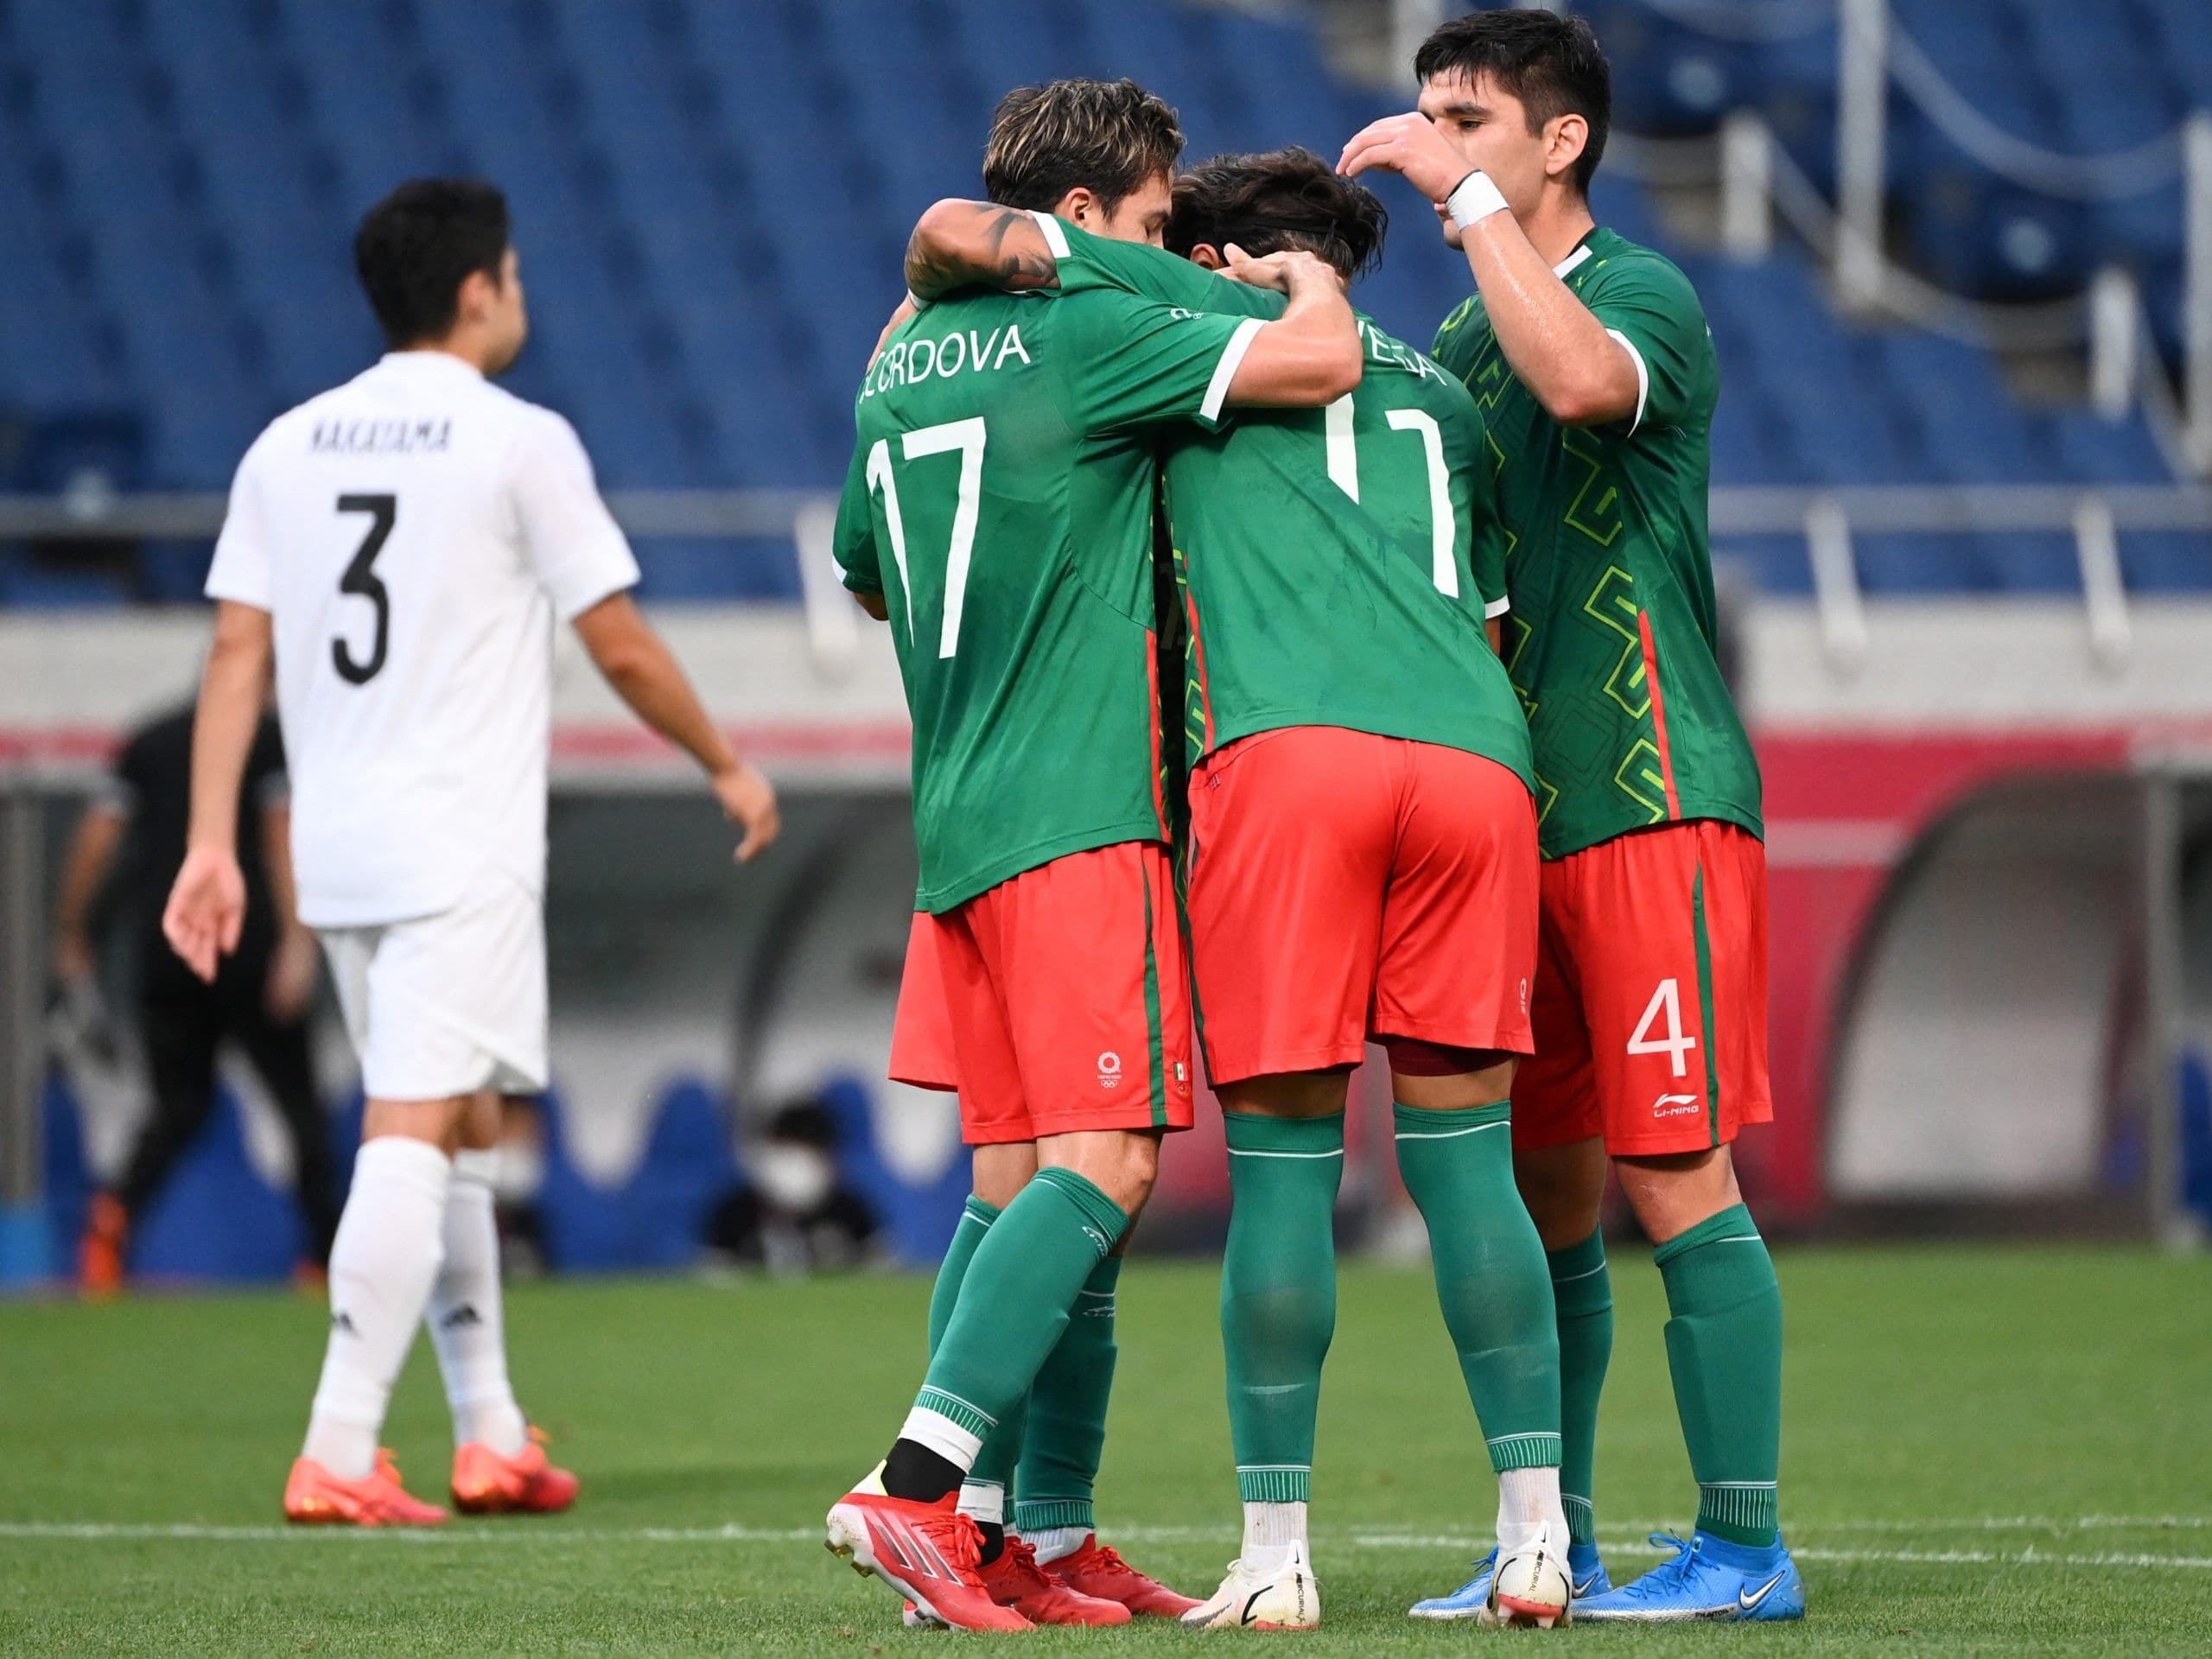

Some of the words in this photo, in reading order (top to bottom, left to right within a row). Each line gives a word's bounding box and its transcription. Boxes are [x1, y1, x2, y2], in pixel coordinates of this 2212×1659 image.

[332, 493, 397, 684] 3
[866, 416, 986, 659] 17
[1627, 978, 1696, 1077] 4
[1654, 1105, 1700, 1117] LI-NING
